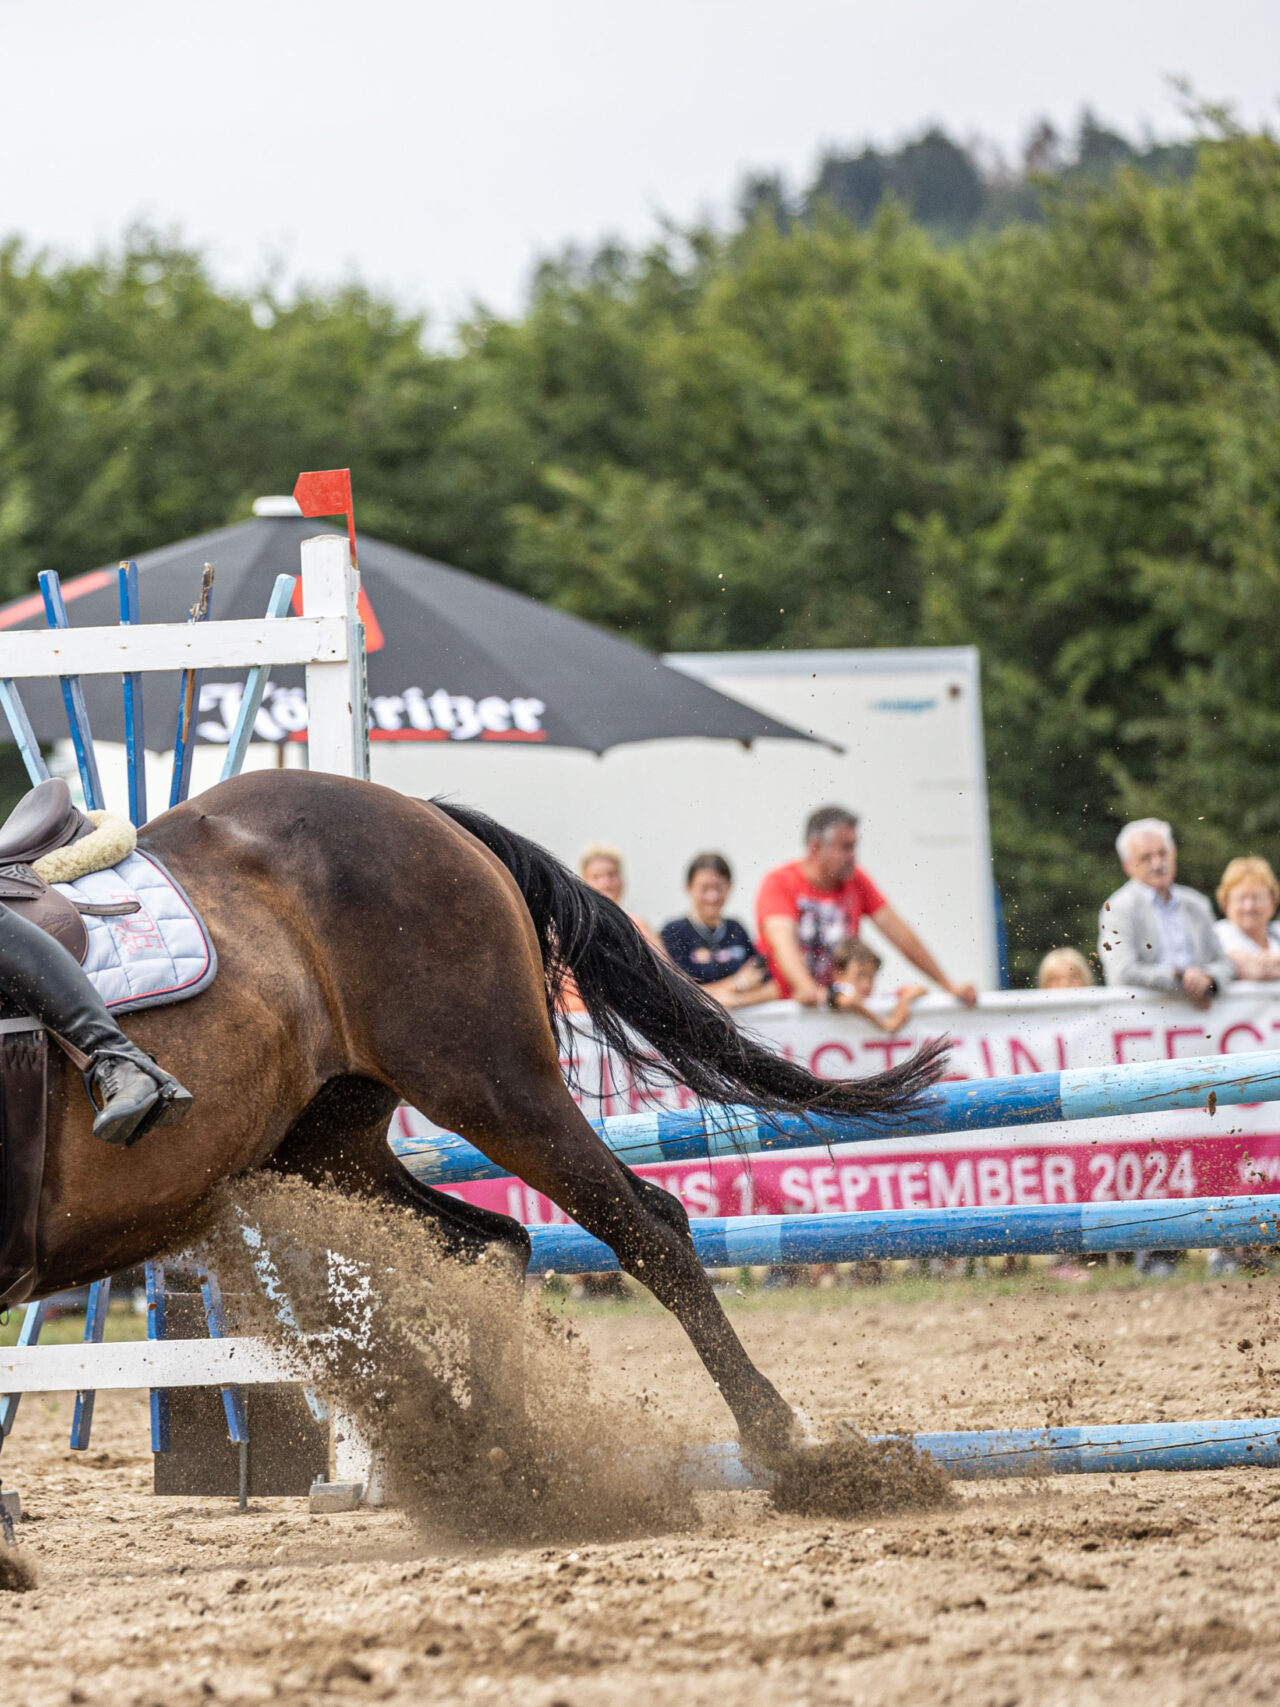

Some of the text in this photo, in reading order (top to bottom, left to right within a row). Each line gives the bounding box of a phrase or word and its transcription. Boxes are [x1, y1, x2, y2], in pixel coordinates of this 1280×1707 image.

[196, 682, 546, 741] Köritzer
[780, 1154, 1076, 1214] SEPTEMBER
[1087, 1149, 1197, 1201] 2024
